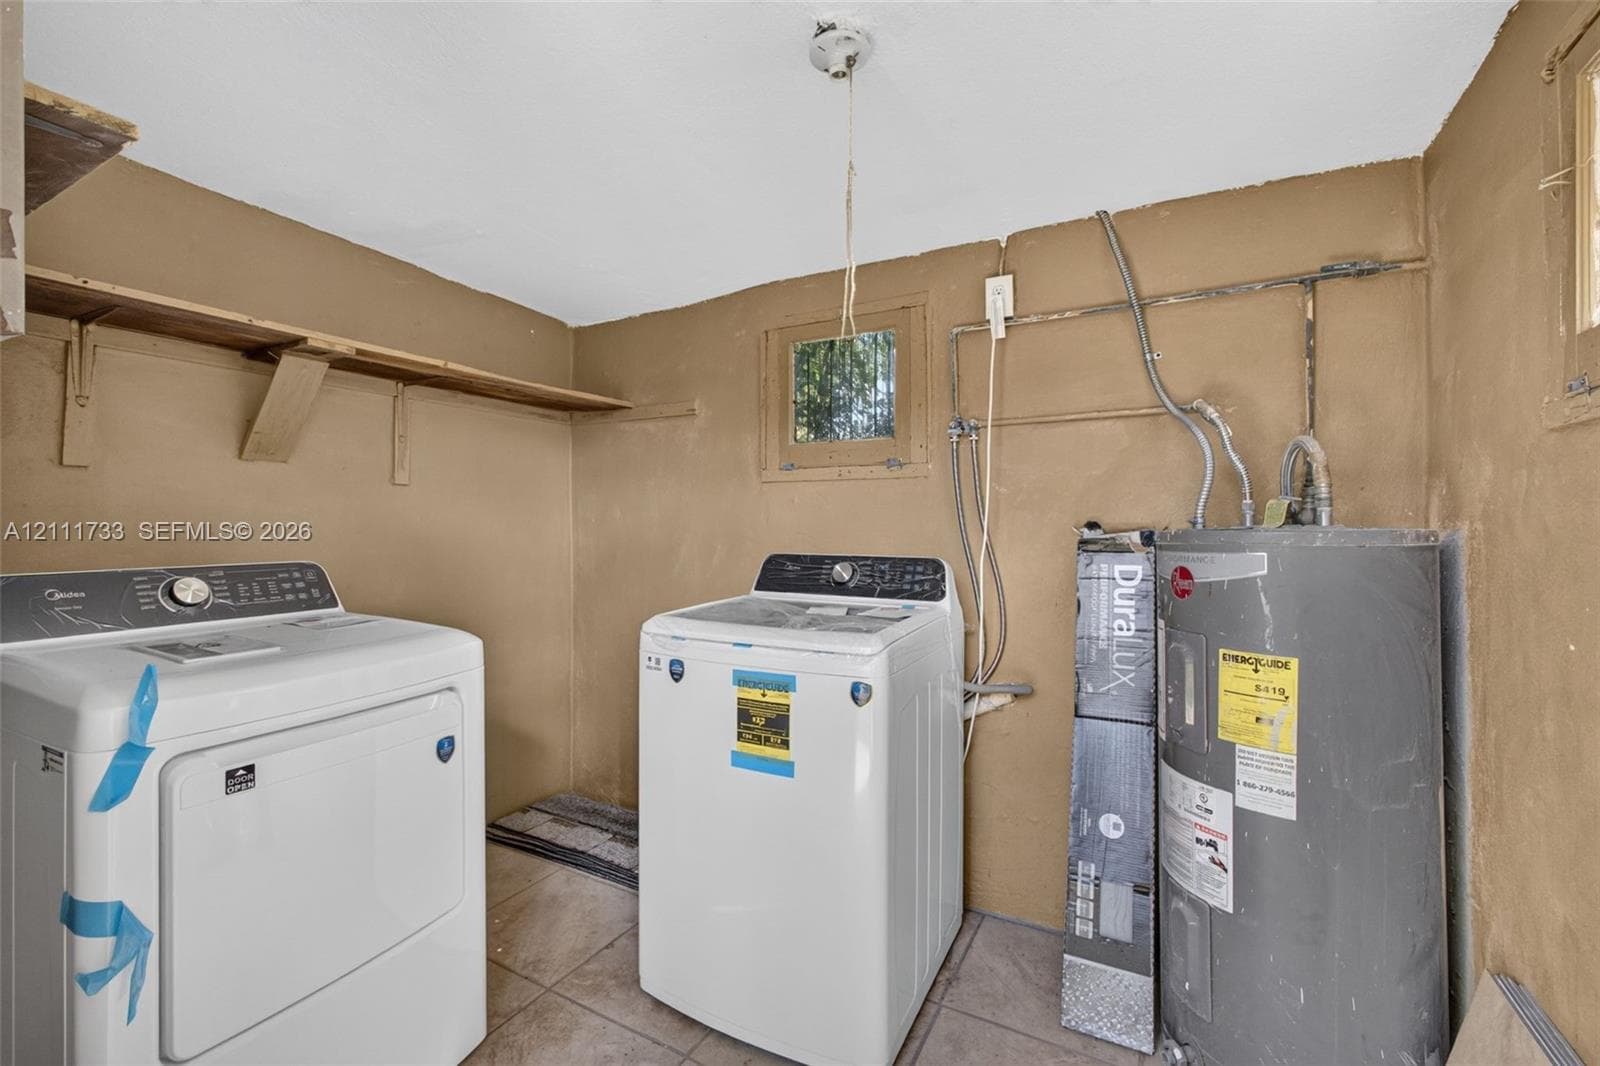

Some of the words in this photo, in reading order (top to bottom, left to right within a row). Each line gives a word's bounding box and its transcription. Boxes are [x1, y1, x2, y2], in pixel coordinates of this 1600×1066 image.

[45, 589, 86, 601] Midea
[1100, 565, 1142, 692] DuraLux
[228, 773, 254, 786] DOOR
[227, 781, 254, 793] OPEN
